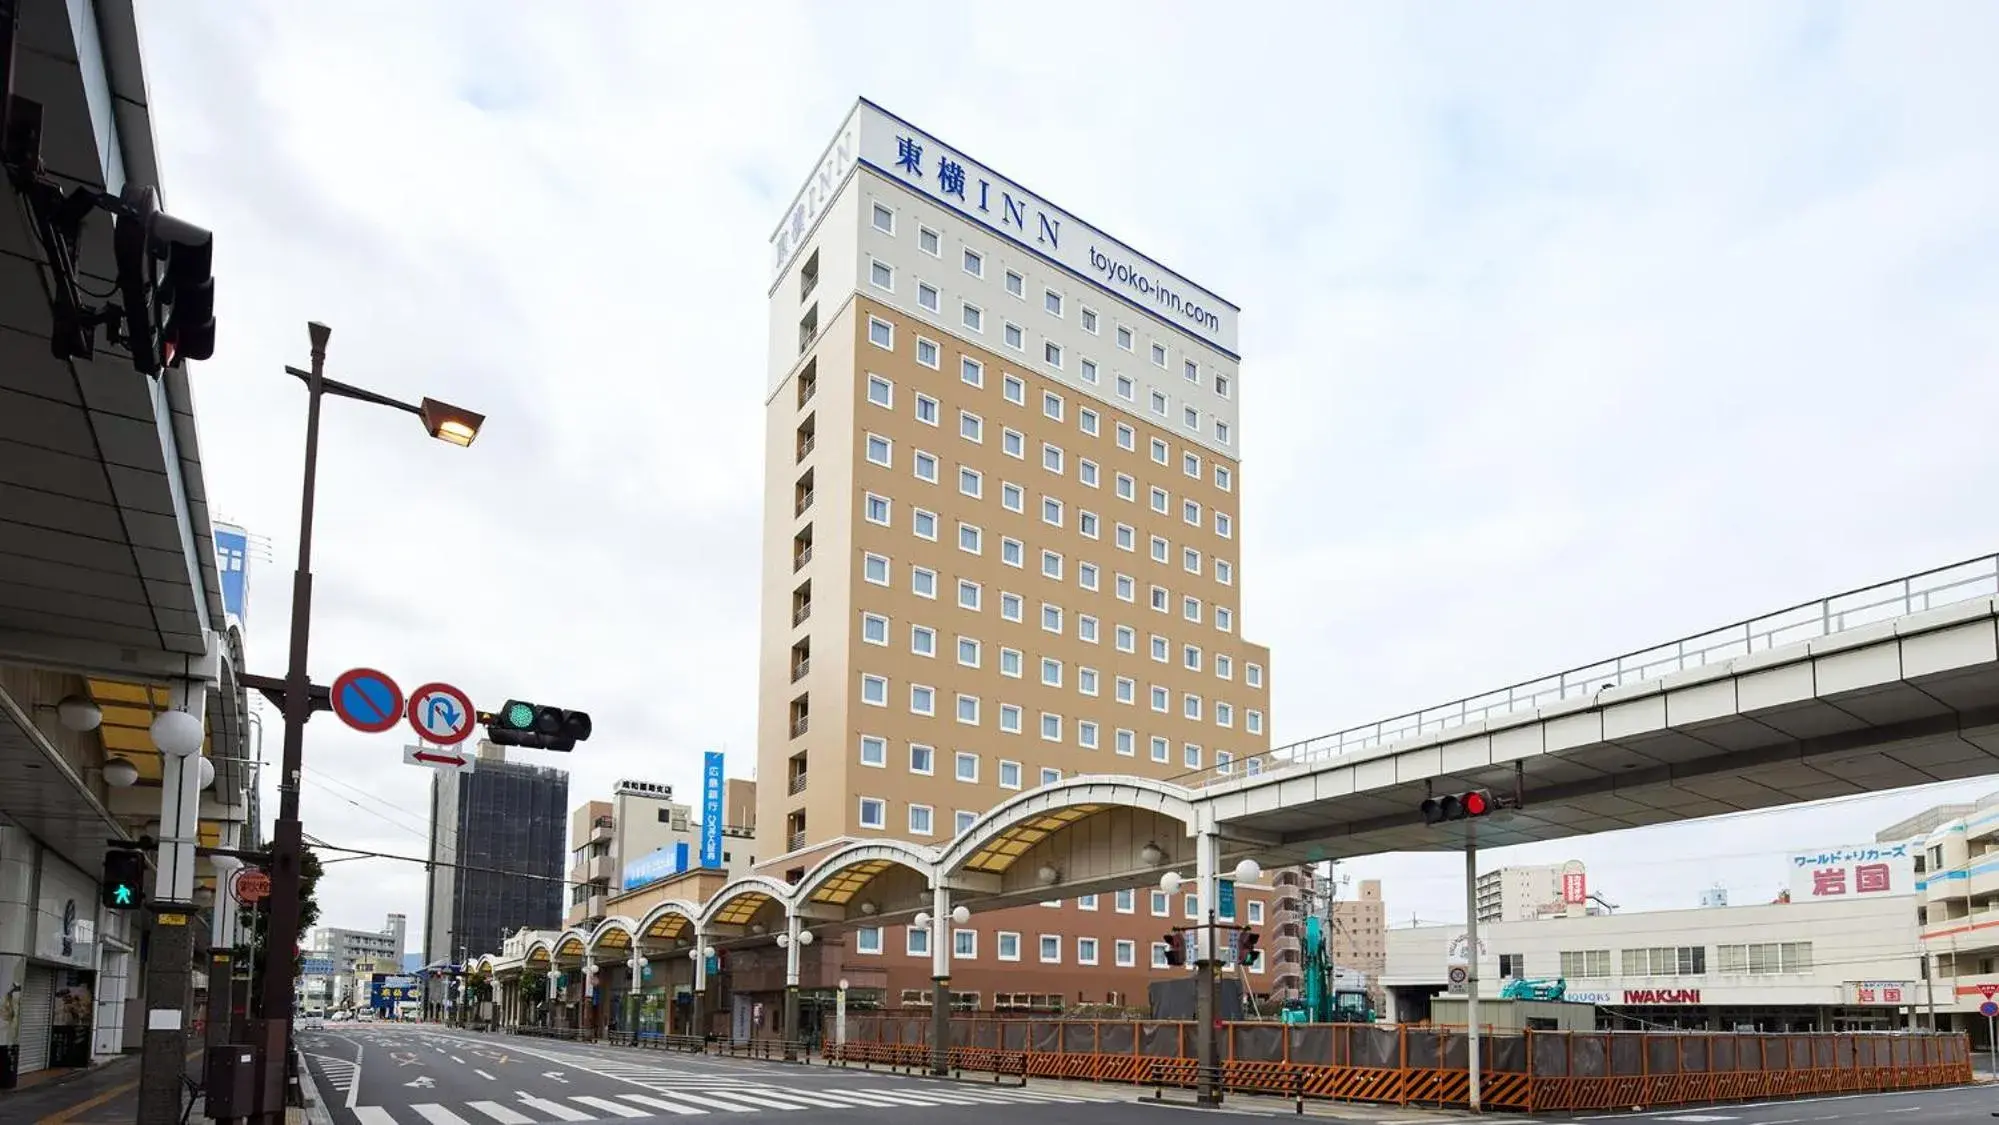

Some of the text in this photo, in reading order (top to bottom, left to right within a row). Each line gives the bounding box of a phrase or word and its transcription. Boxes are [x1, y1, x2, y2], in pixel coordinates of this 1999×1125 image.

[895, 135, 1061, 250] 東横INN
[1090, 245, 1219, 333] toyoko-inn.com
[1811, 863, 1891, 896] 岩国
[1623, 988, 1701, 1004] IWAKUNI
